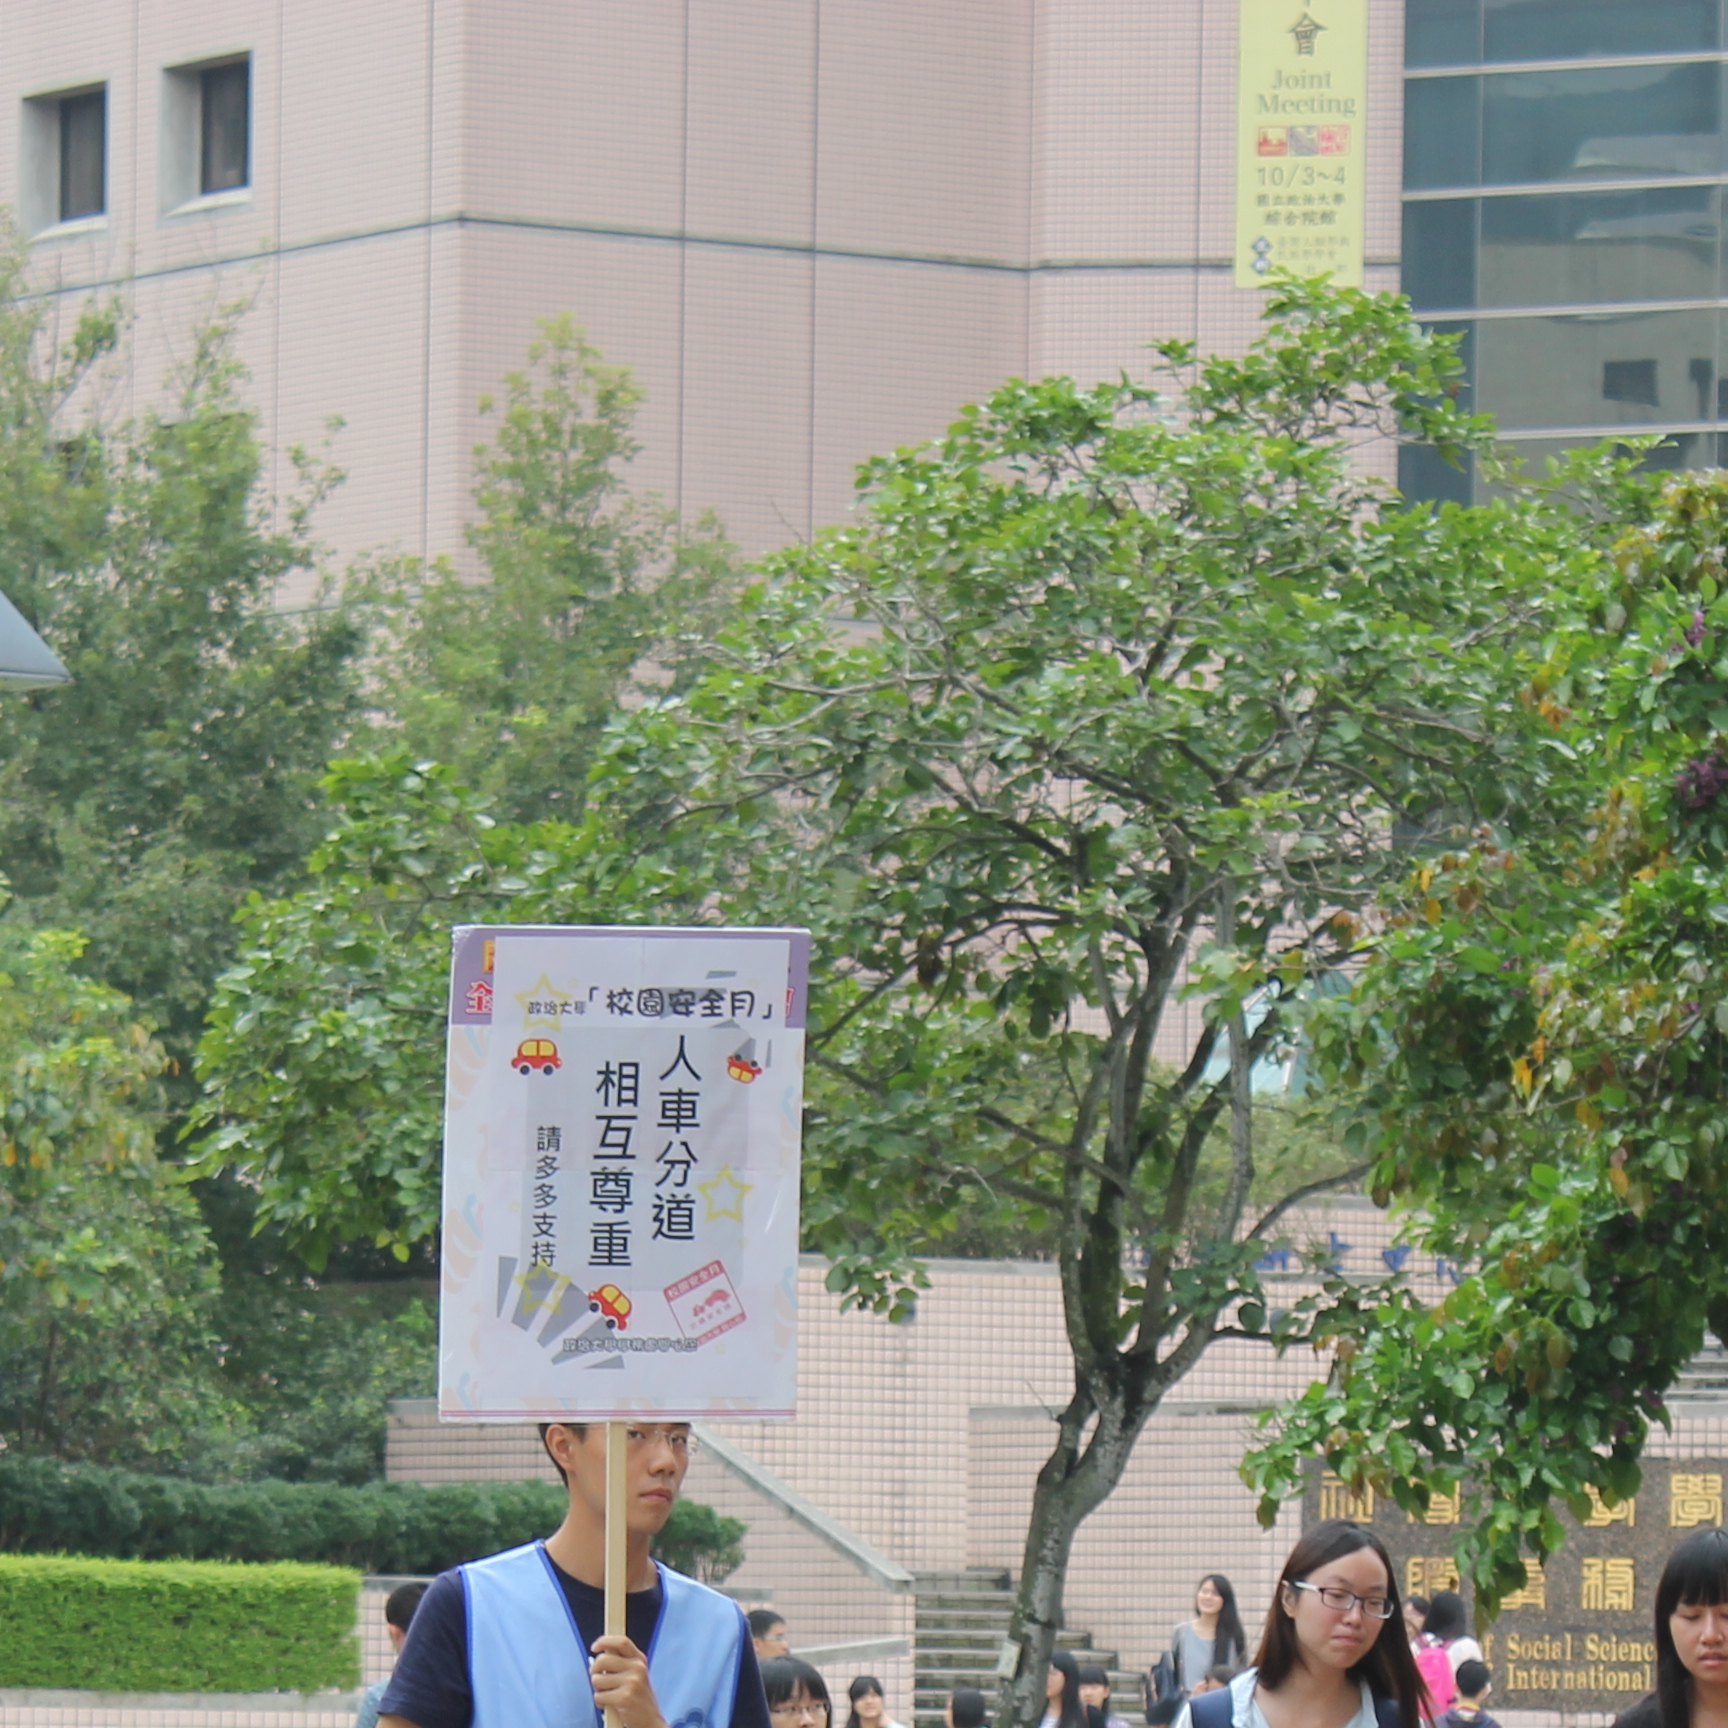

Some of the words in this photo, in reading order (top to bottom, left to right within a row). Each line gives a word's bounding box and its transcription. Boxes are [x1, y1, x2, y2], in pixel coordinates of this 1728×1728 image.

[1272, 69, 1332, 90] Joint
[1257, 94, 1356, 117] Meeting
[1257, 164, 1346, 188] 10/3~4
[651, 1034, 702, 1241] 人車分道
[588, 1060, 640, 1267] 相互尊重
[531, 1125, 562, 1268] 請多多支持
[1506, 1632, 1573, 1661] Social
[1585, 1633, 1657, 1662] Scienc
[1506, 1662, 1653, 1691] International
